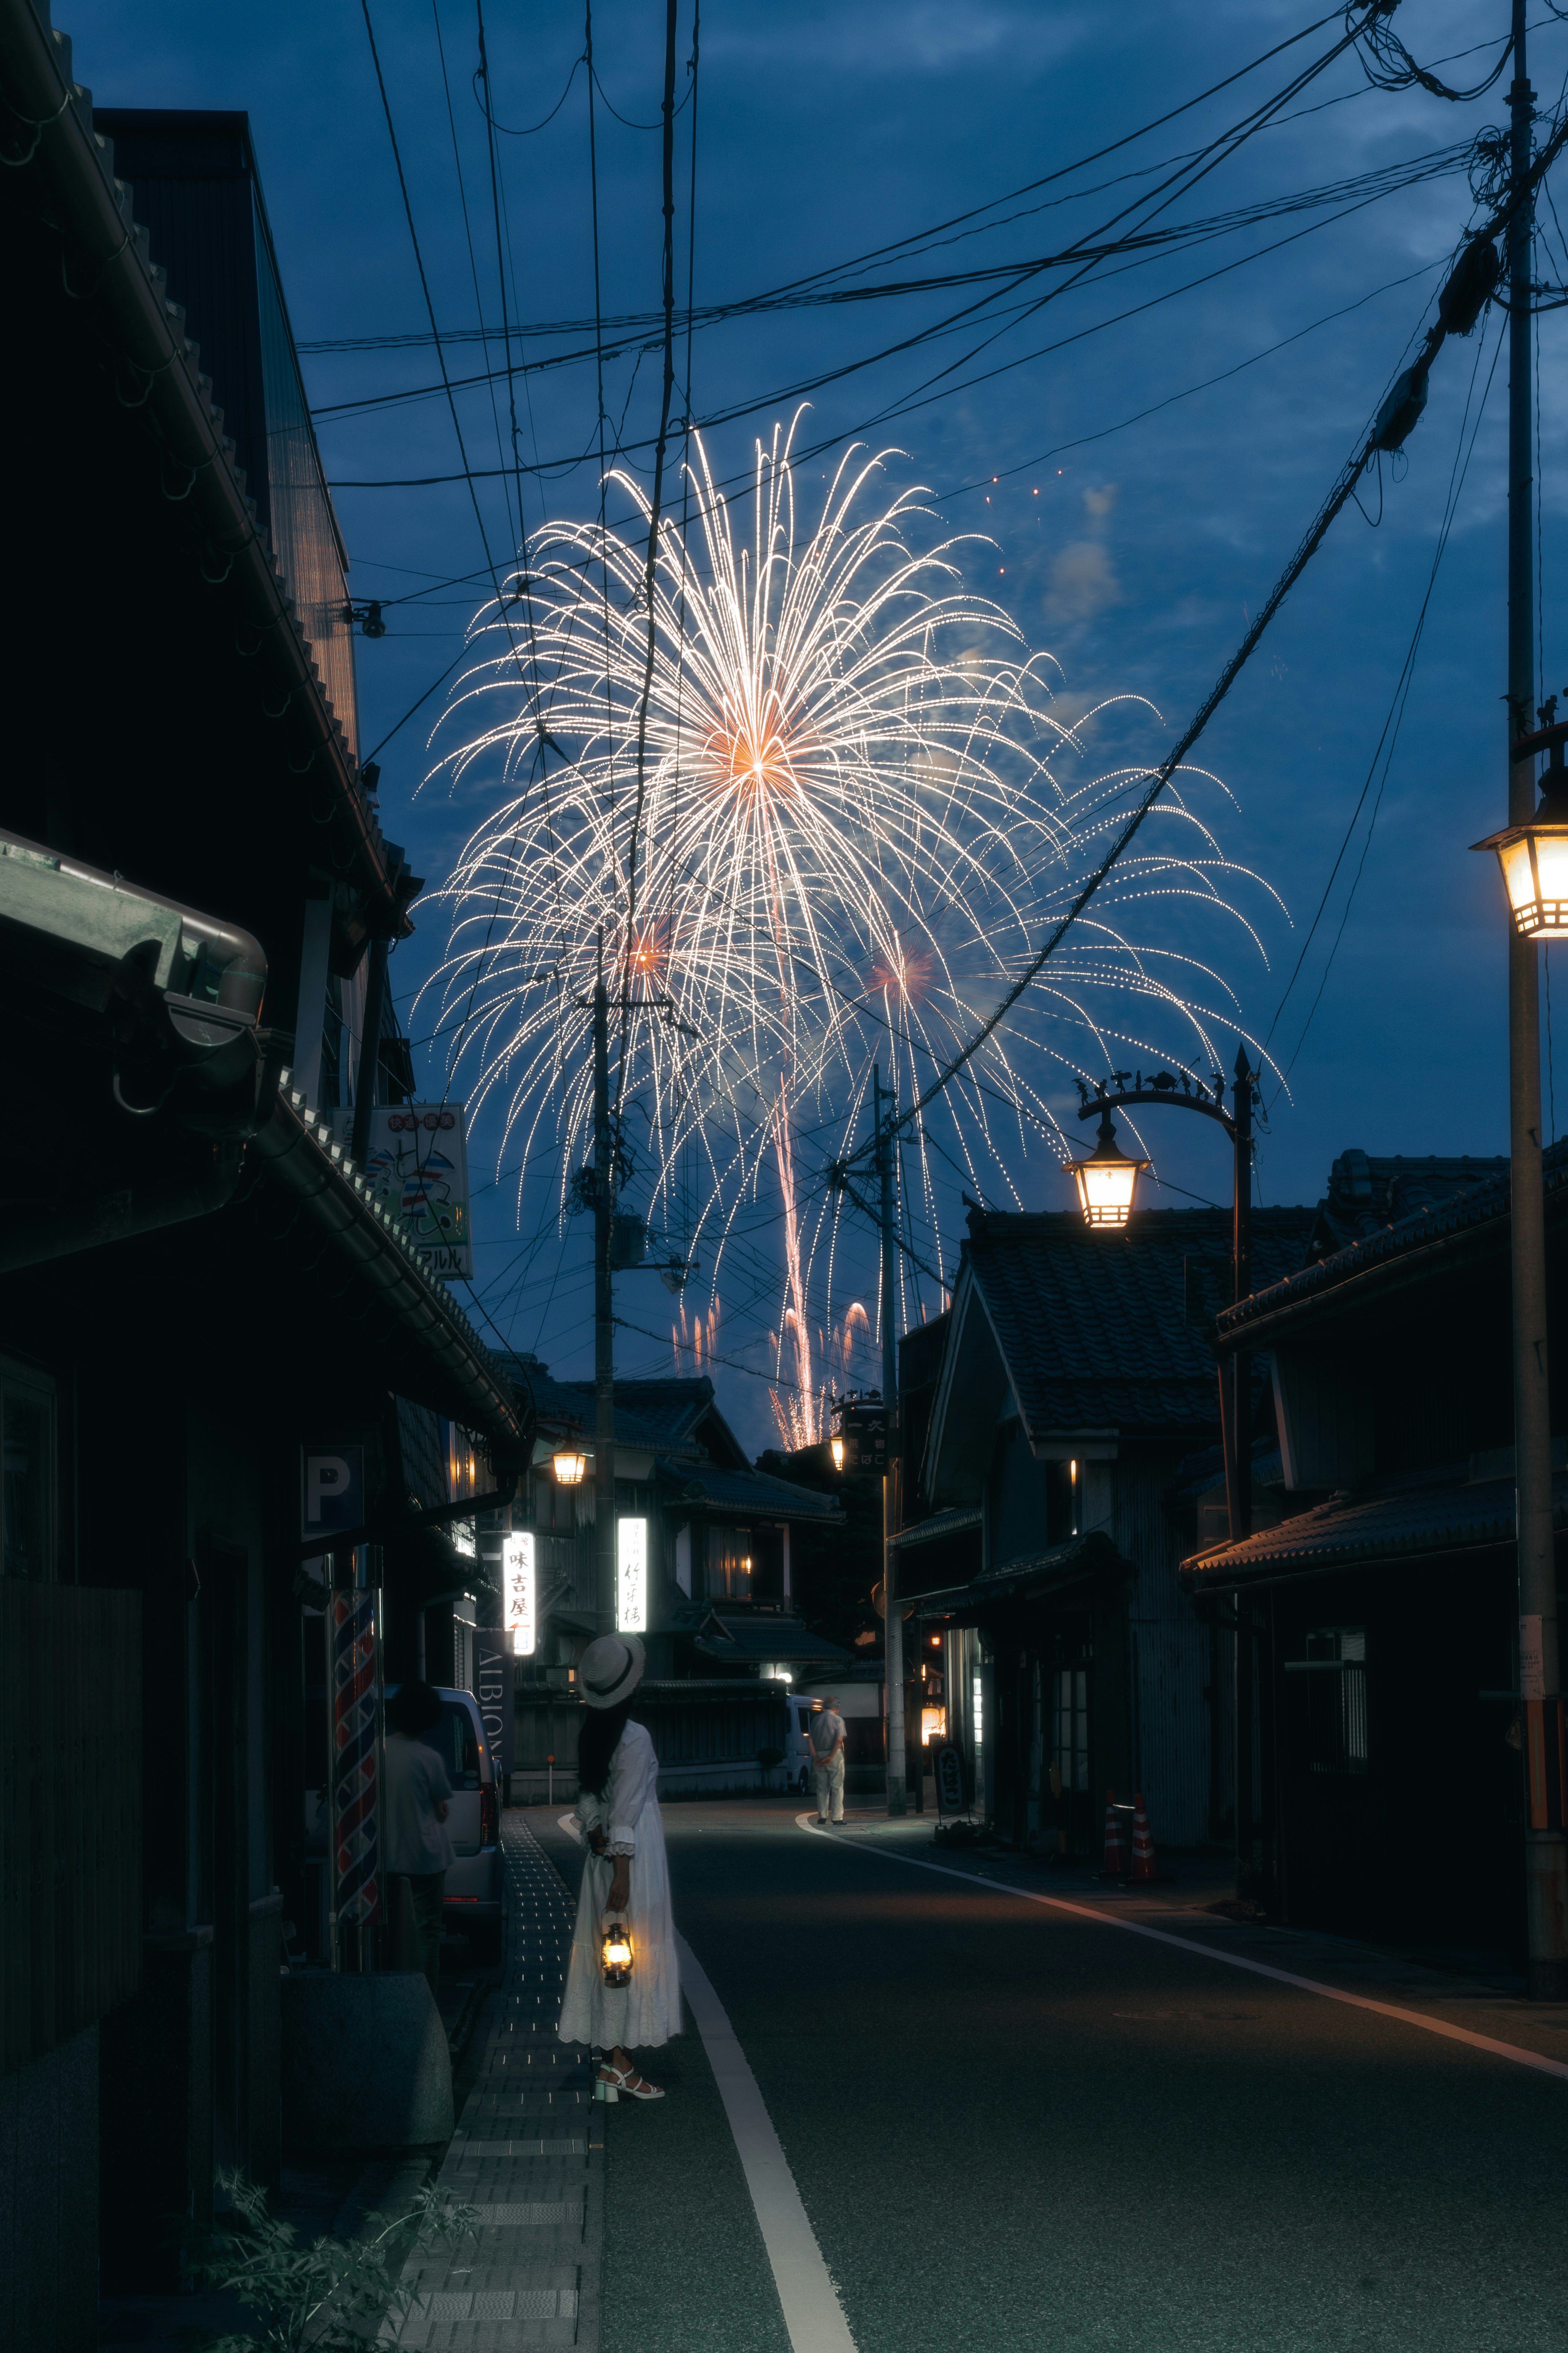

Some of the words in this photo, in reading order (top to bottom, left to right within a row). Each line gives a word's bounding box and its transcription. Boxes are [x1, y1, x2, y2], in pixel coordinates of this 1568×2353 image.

[848, 1419, 885, 1432] 一久
[848, 1439, 885, 1449] 荒物
[848, 1454, 885, 1465] たばこ
[308, 1456, 351, 1521] P
[509, 1550, 529, 1617] 味吉屋
[941, 1752, 960, 1805] たばこ
